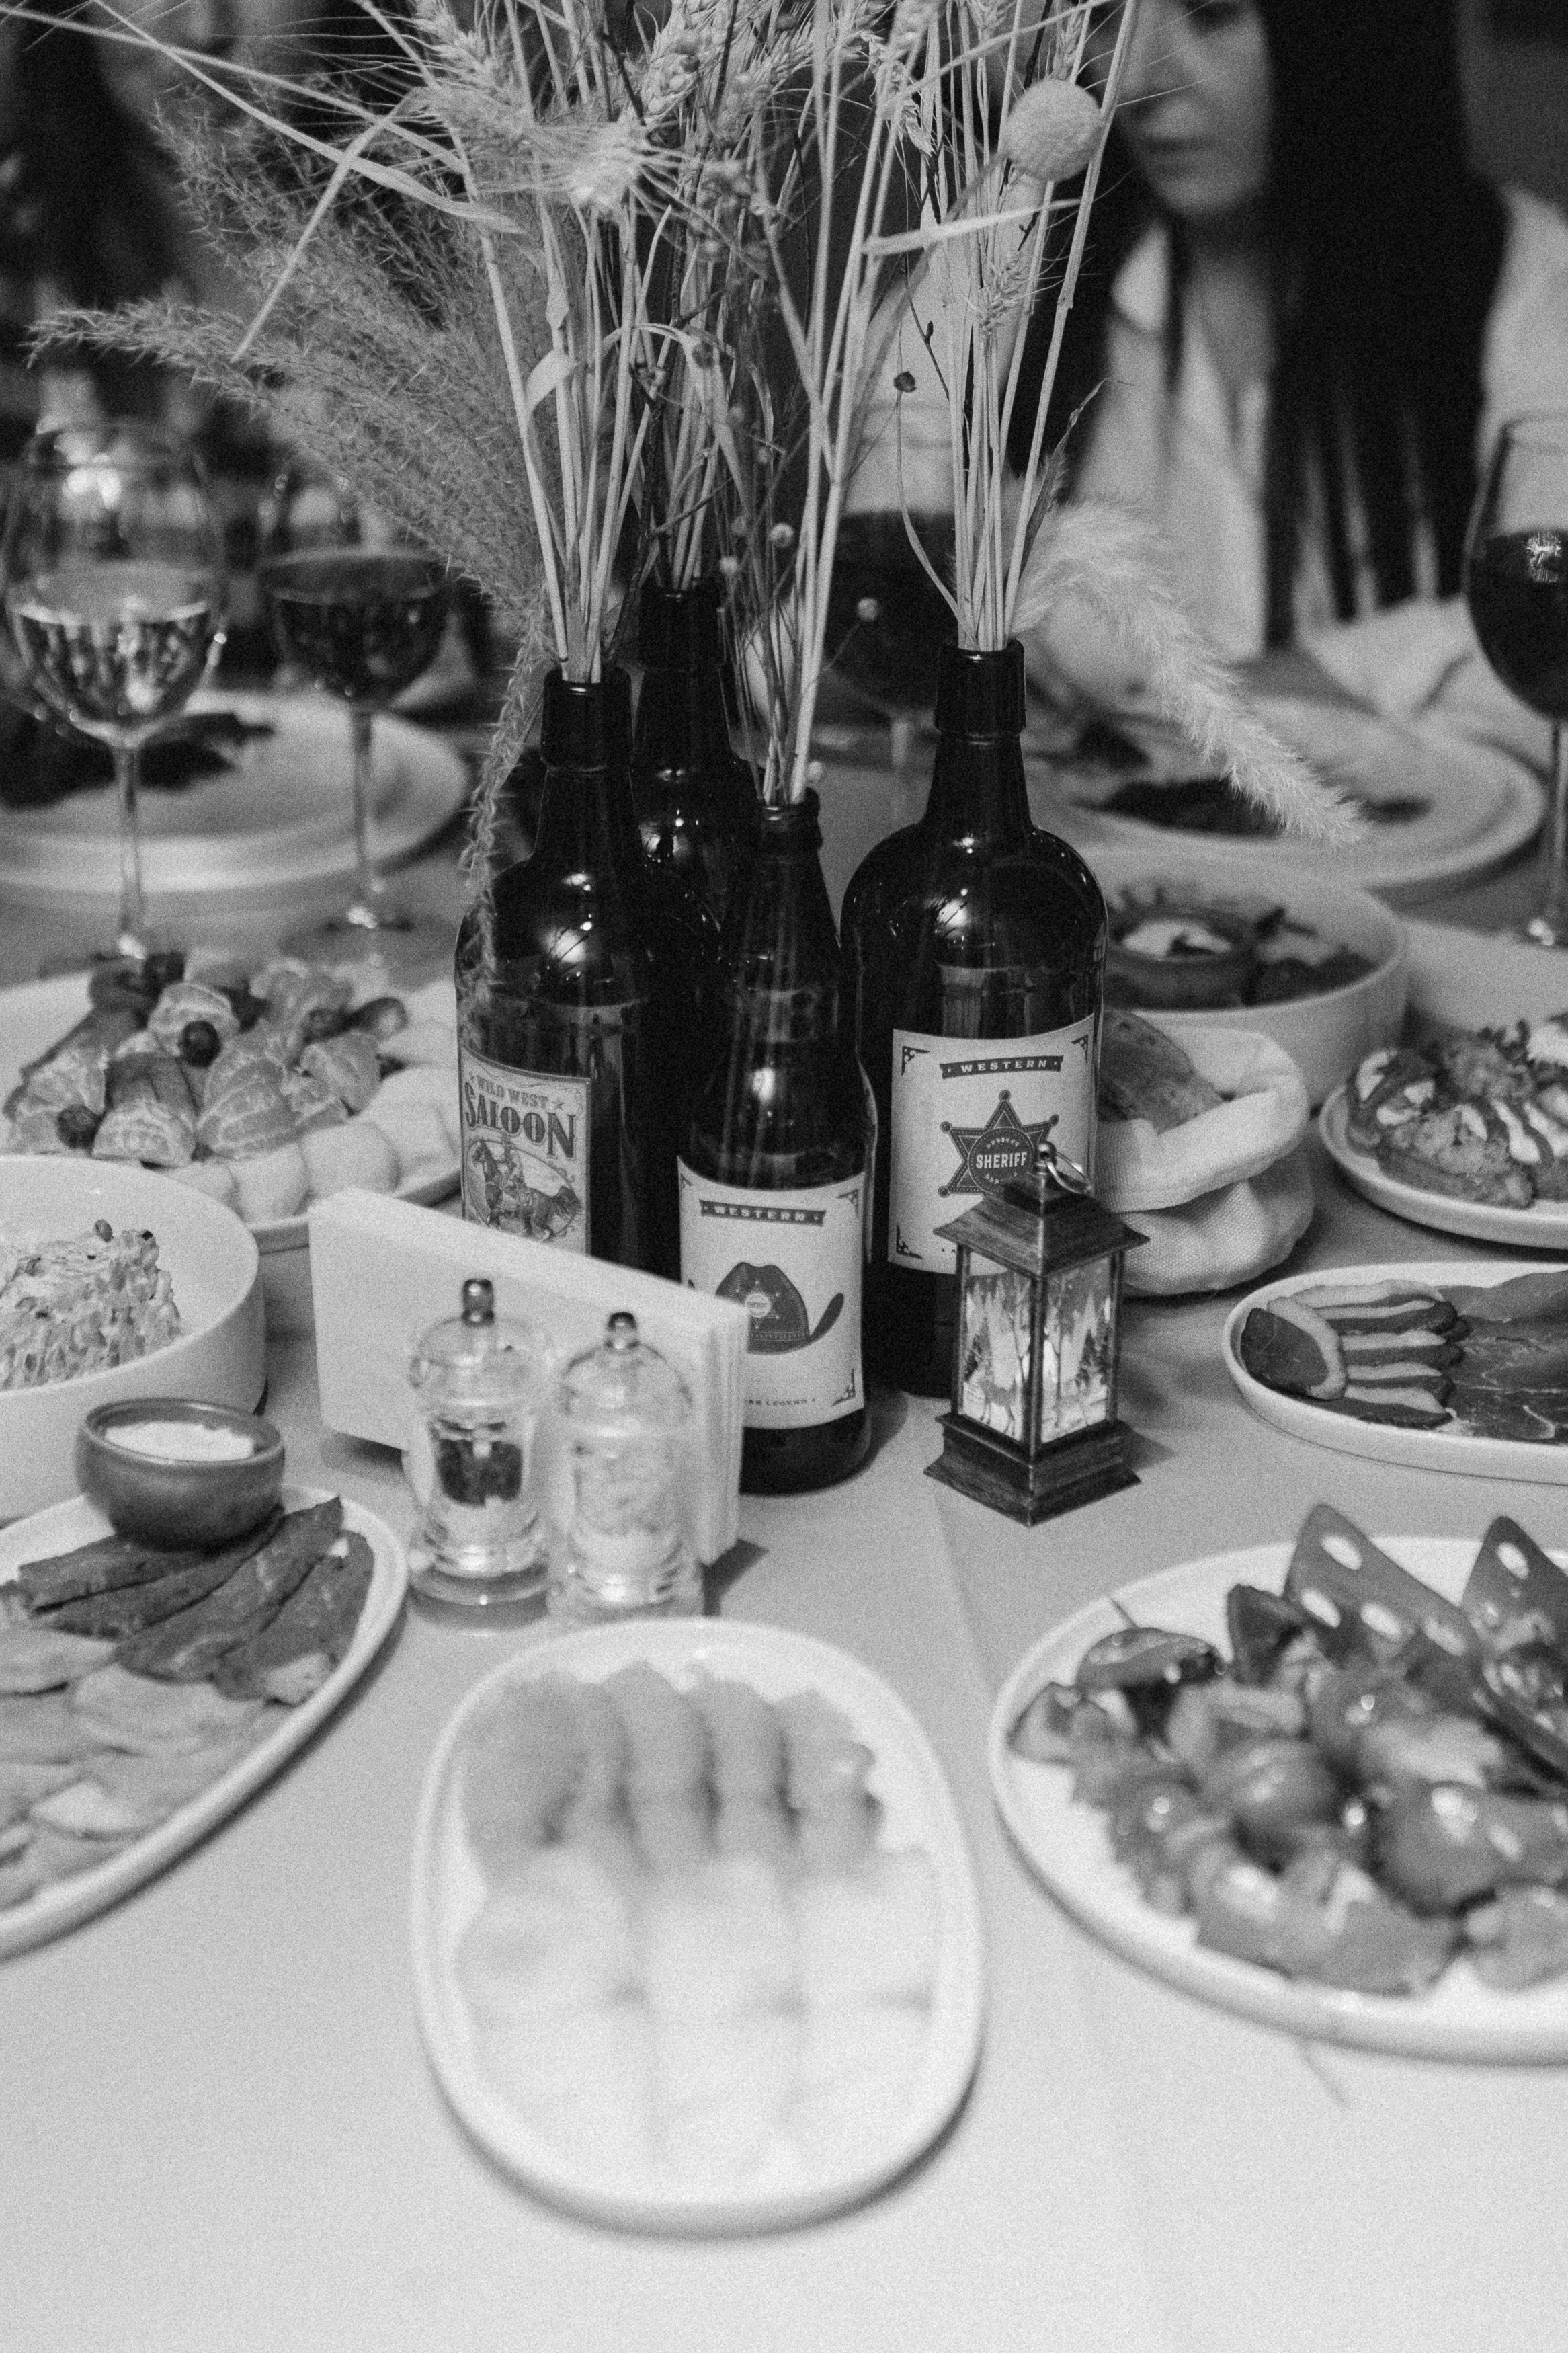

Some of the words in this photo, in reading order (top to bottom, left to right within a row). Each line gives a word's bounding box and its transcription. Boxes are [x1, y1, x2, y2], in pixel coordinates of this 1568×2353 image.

[960, 1059, 1047, 1073] WESTERN
[477, 1076, 505, 1098] WILD
[508, 1088, 548, 1109] WEST
[464, 1082, 577, 1159] SALOON
[976, 1152, 1027, 1169] SHERIFF
[714, 1206, 805, 1222] WESTERN
